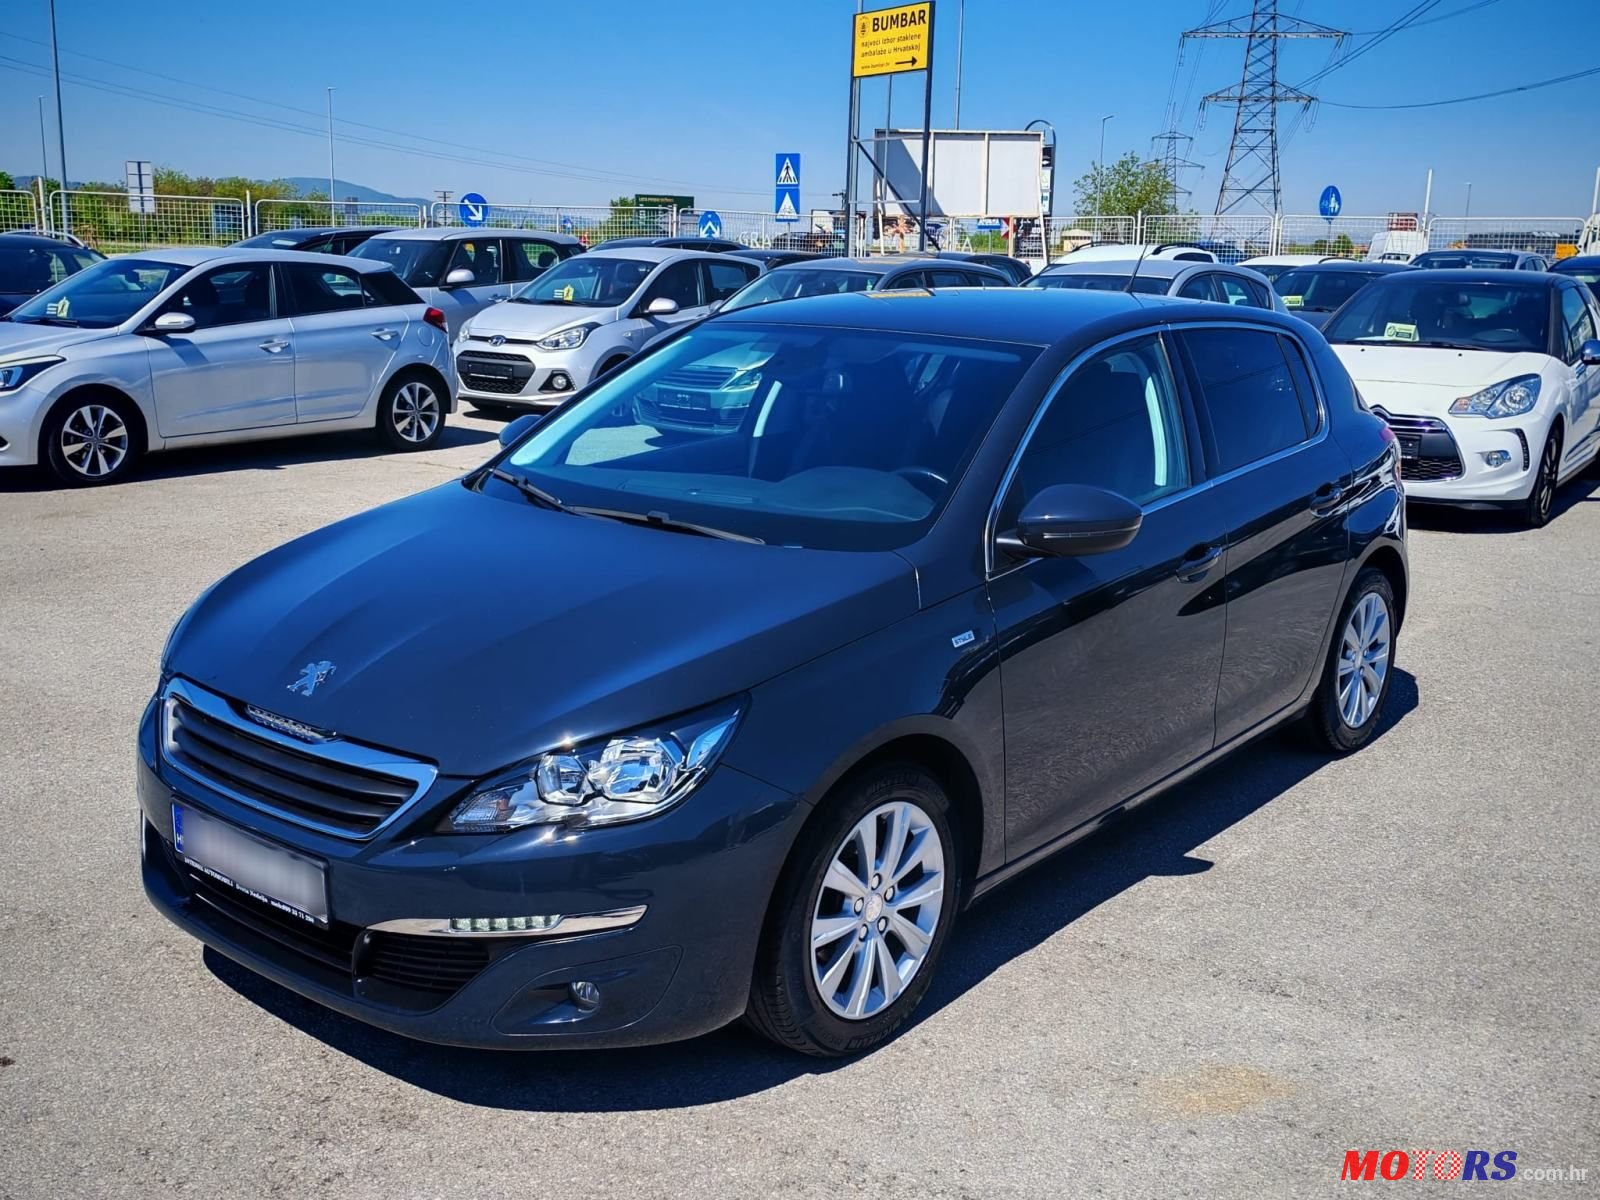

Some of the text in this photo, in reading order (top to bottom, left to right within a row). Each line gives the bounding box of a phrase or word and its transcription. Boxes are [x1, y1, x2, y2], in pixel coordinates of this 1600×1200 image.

[872, 9, 926, 32] BUMBAR
[882, 37, 895, 45] izbor
[897, 33, 921, 42] staklene
[893, 43, 920, 52] Hrvatskoj
